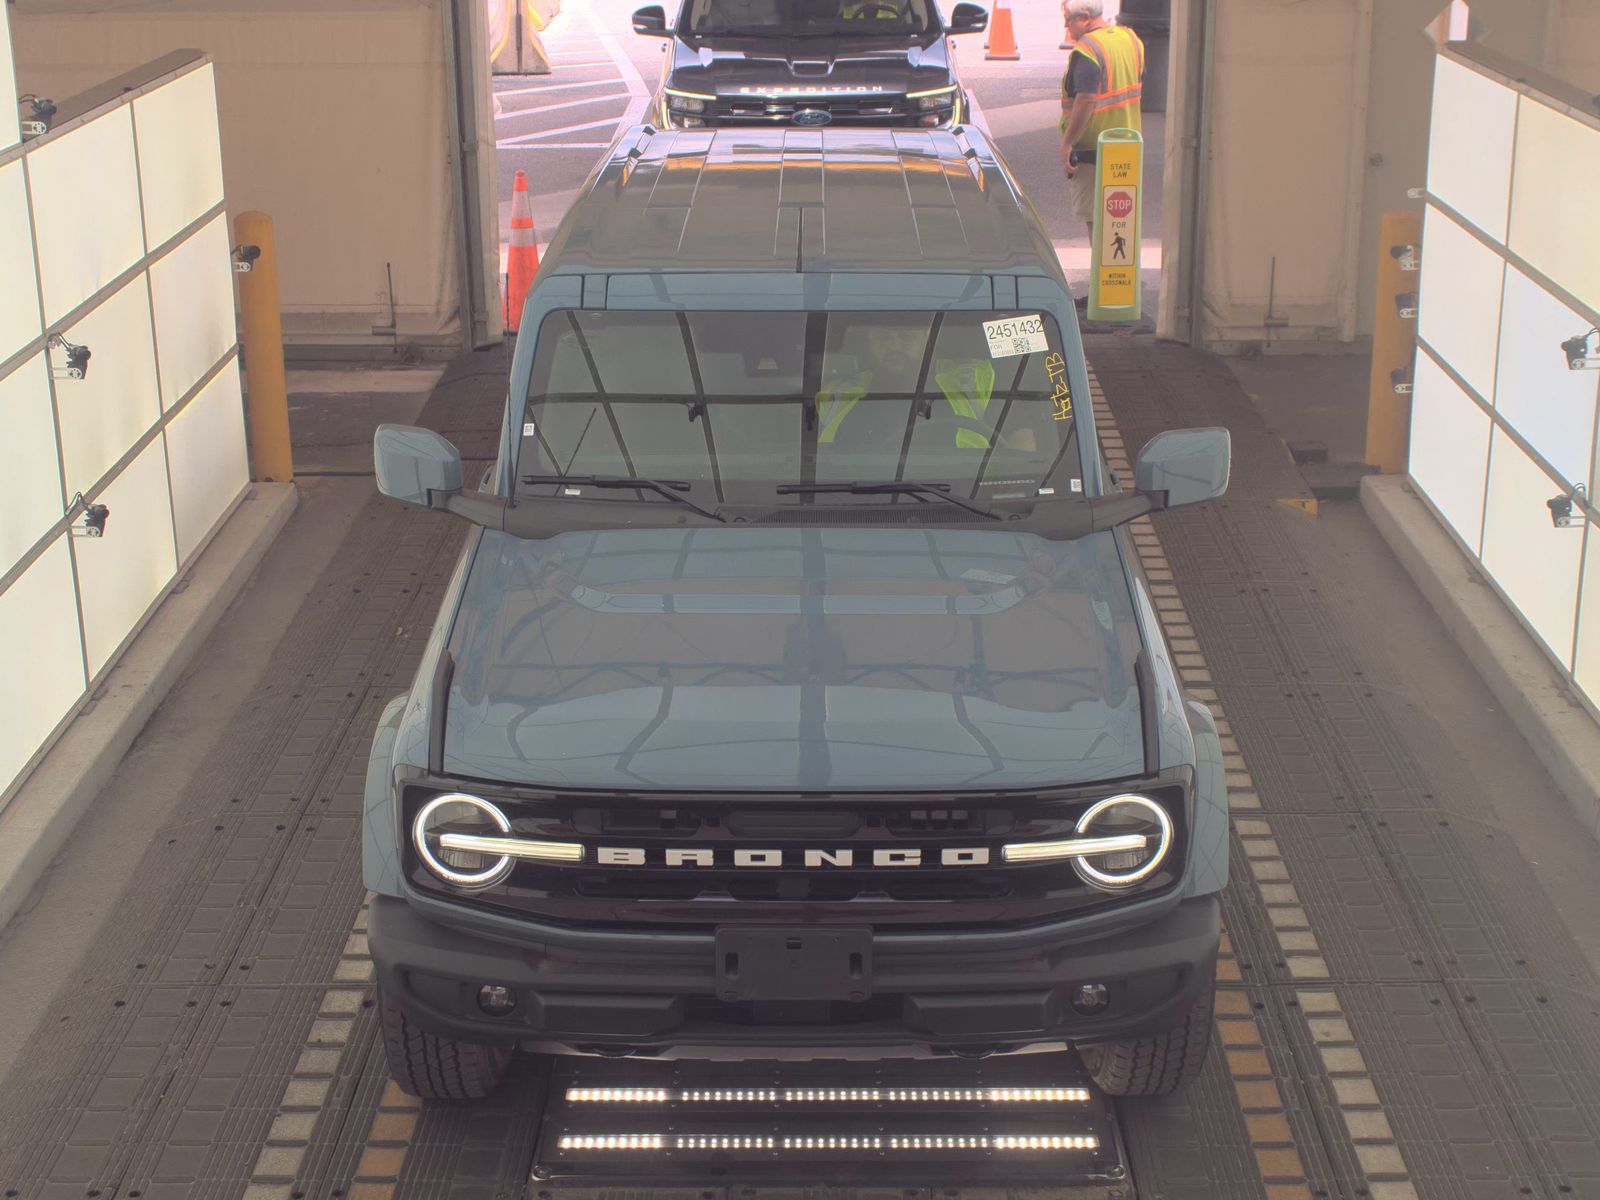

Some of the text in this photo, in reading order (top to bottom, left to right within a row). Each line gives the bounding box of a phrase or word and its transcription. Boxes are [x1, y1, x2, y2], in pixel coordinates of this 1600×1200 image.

[739, 85, 883, 94] EXPEDITION
[1110, 163, 1132, 171] STATE
[1107, 199, 1132, 210] STOP
[987, 319, 1045, 340] 2451432
[597, 846, 991, 868] BRONCO
